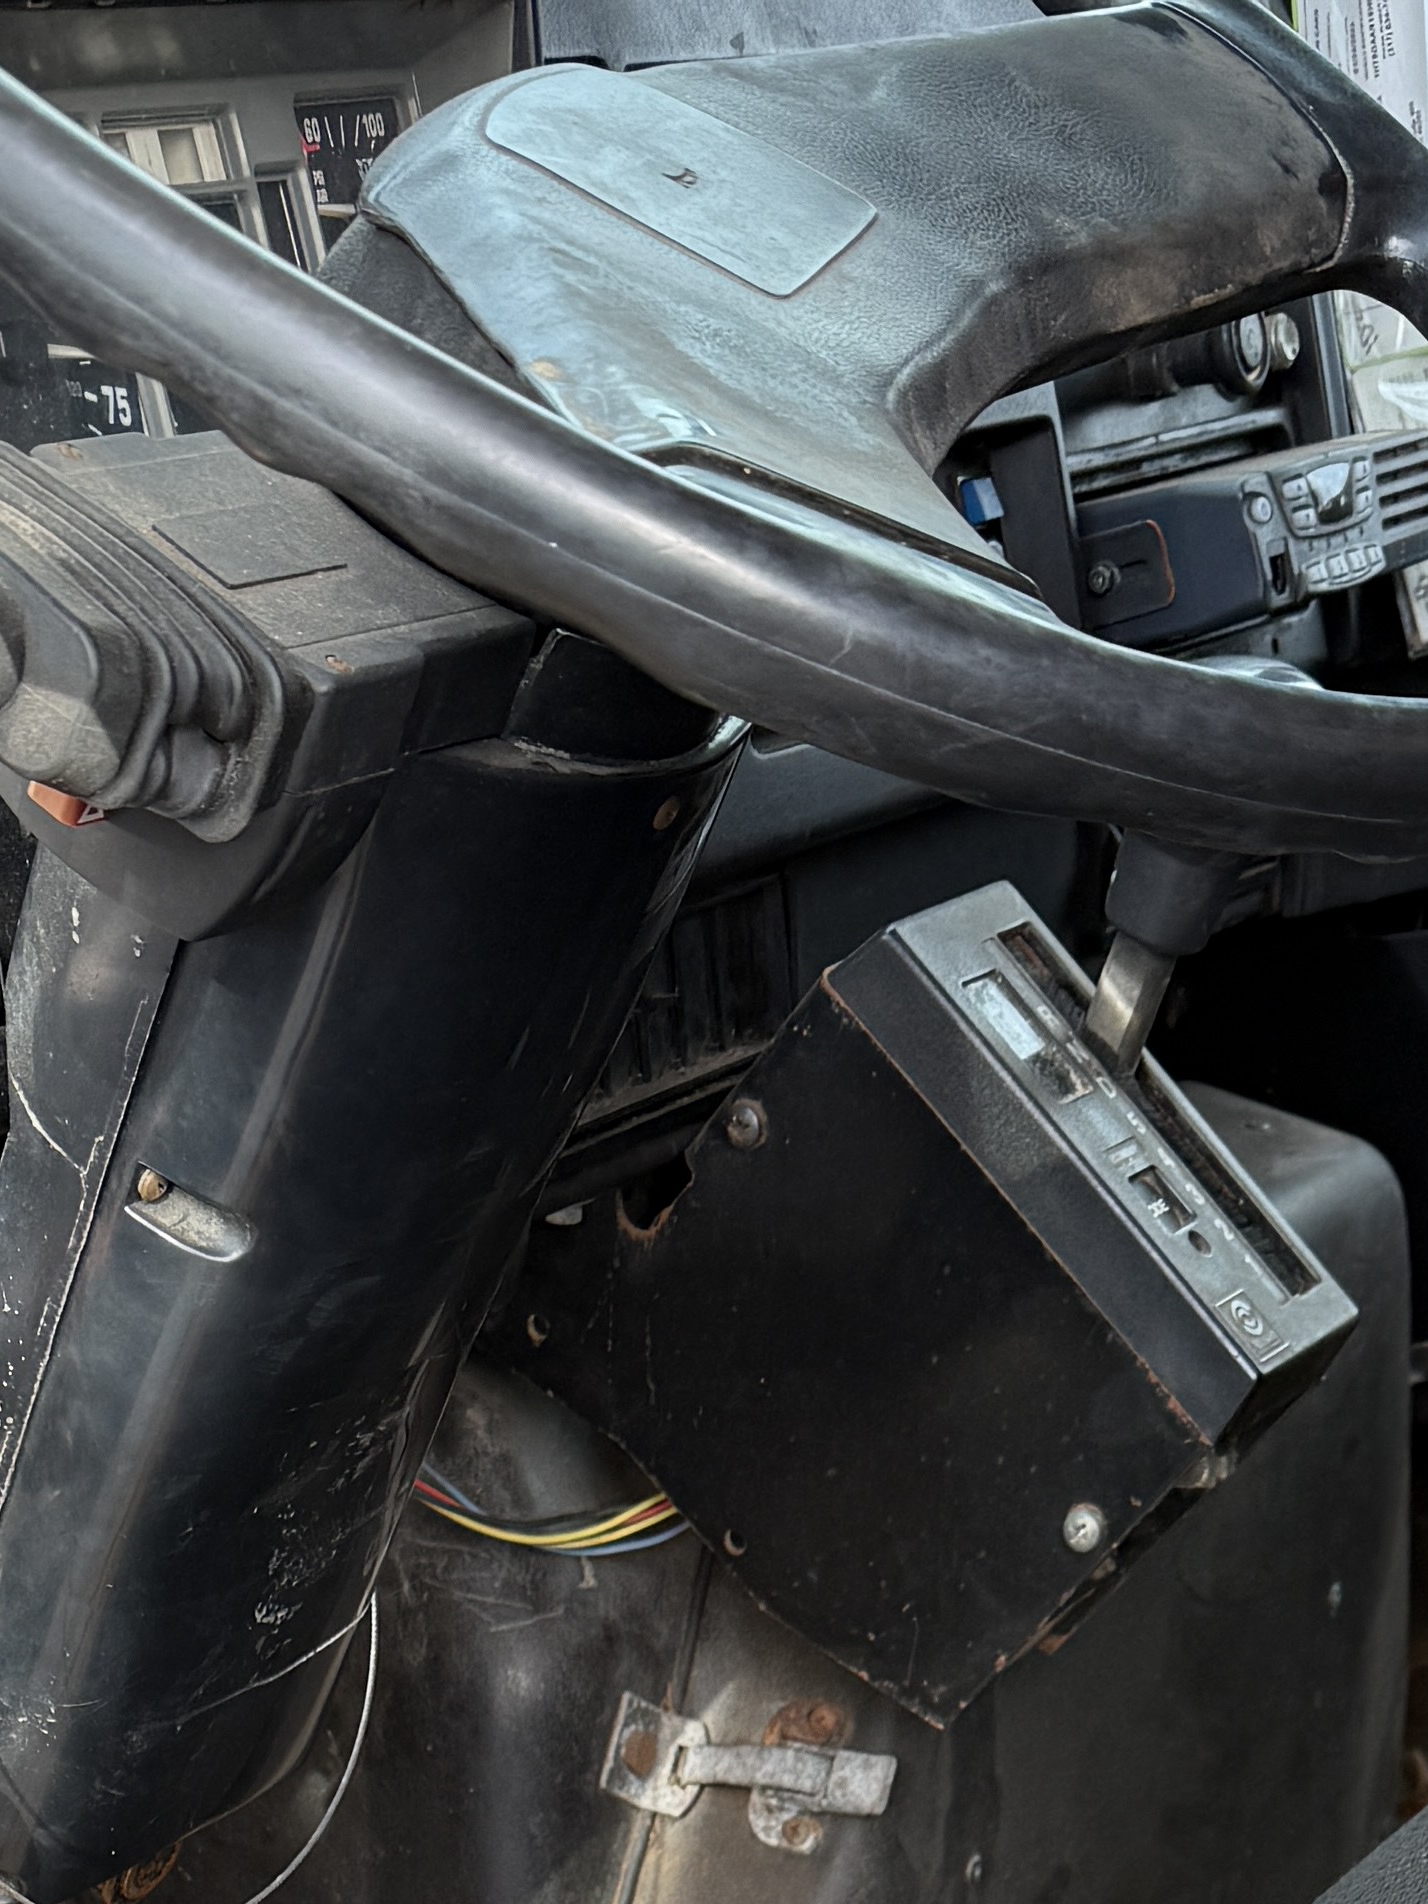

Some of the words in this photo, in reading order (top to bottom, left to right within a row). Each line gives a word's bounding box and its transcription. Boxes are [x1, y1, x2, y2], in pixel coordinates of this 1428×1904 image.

[303, 117, 321, 143] 60
[362, 112, 385, 138] 100
[100, 385, 132, 427] 75
[1095, 1076, 1117, 1099] D
[1185, 1183, 1205, 1206] 3
[1213, 1218, 1235, 1241] 2
